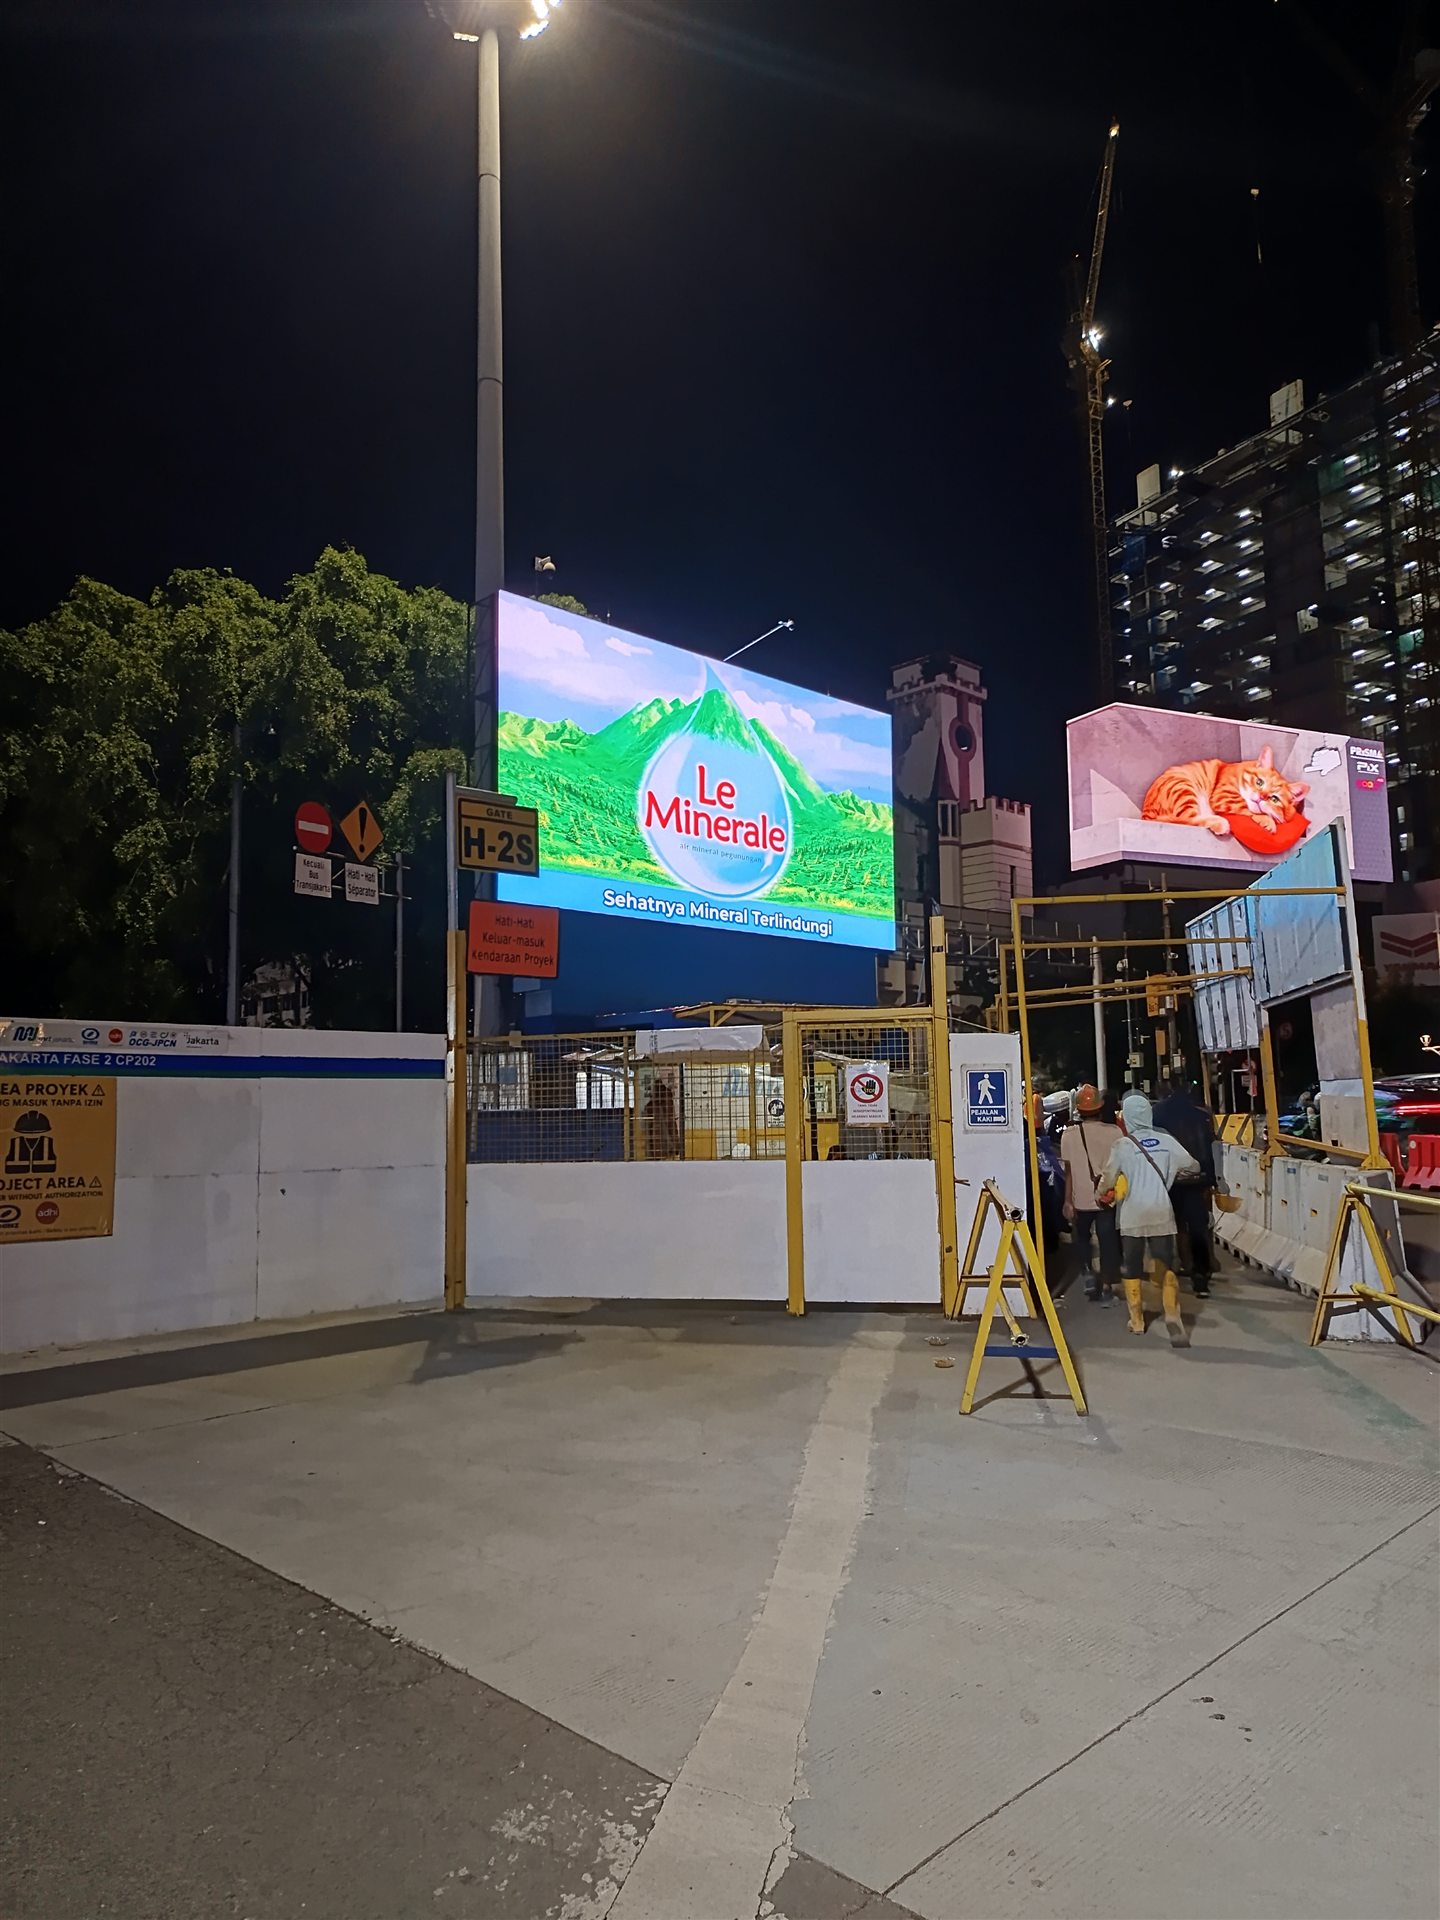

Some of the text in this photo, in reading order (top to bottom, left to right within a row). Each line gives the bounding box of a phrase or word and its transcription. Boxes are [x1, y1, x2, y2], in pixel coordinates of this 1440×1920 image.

[698, 765, 735, 809] Le
[486, 807, 513, 820] GATE
[645, 790, 785, 852] Minerale
[463, 826, 534, 866] H-2S
[692, 844, 719, 855] mineral
[720, 849, 762, 863] pegunungan
[303, 859, 325, 870] Kecuali
[309, 870, 319, 880] Bus
[296, 880, 331, 893] Transjakarta
[347, 883, 377, 898] Separator
[603, 888, 833, 937] Sehatnya Mineral Terlindungi
[495, 915, 535, 929] Hati-Hati
[482, 932, 545, 948] Keluar-masuk
[472, 951, 554, 968] Kendaraan Proyek
[128, 1038, 177, 1047] OCG-JPCN
[186, 1036, 219, 1046] Jakarta
[63, 1053, 100, 1065] FASE
[104, 1055, 112, 1065] 2
[115, 1055, 157, 1066] CP202
[0, 1083, 88, 1096] EA PROYEK
[0, 1099, 103, 1107] G MASUK TANPA IZIN
[46, 1177, 86, 1189] AREA
[8, 1193, 43, 1201] WITHOUT
[45, 1191, 104, 1199] AUTHORIZATION
[37, 1208, 58, 1217] adhi
